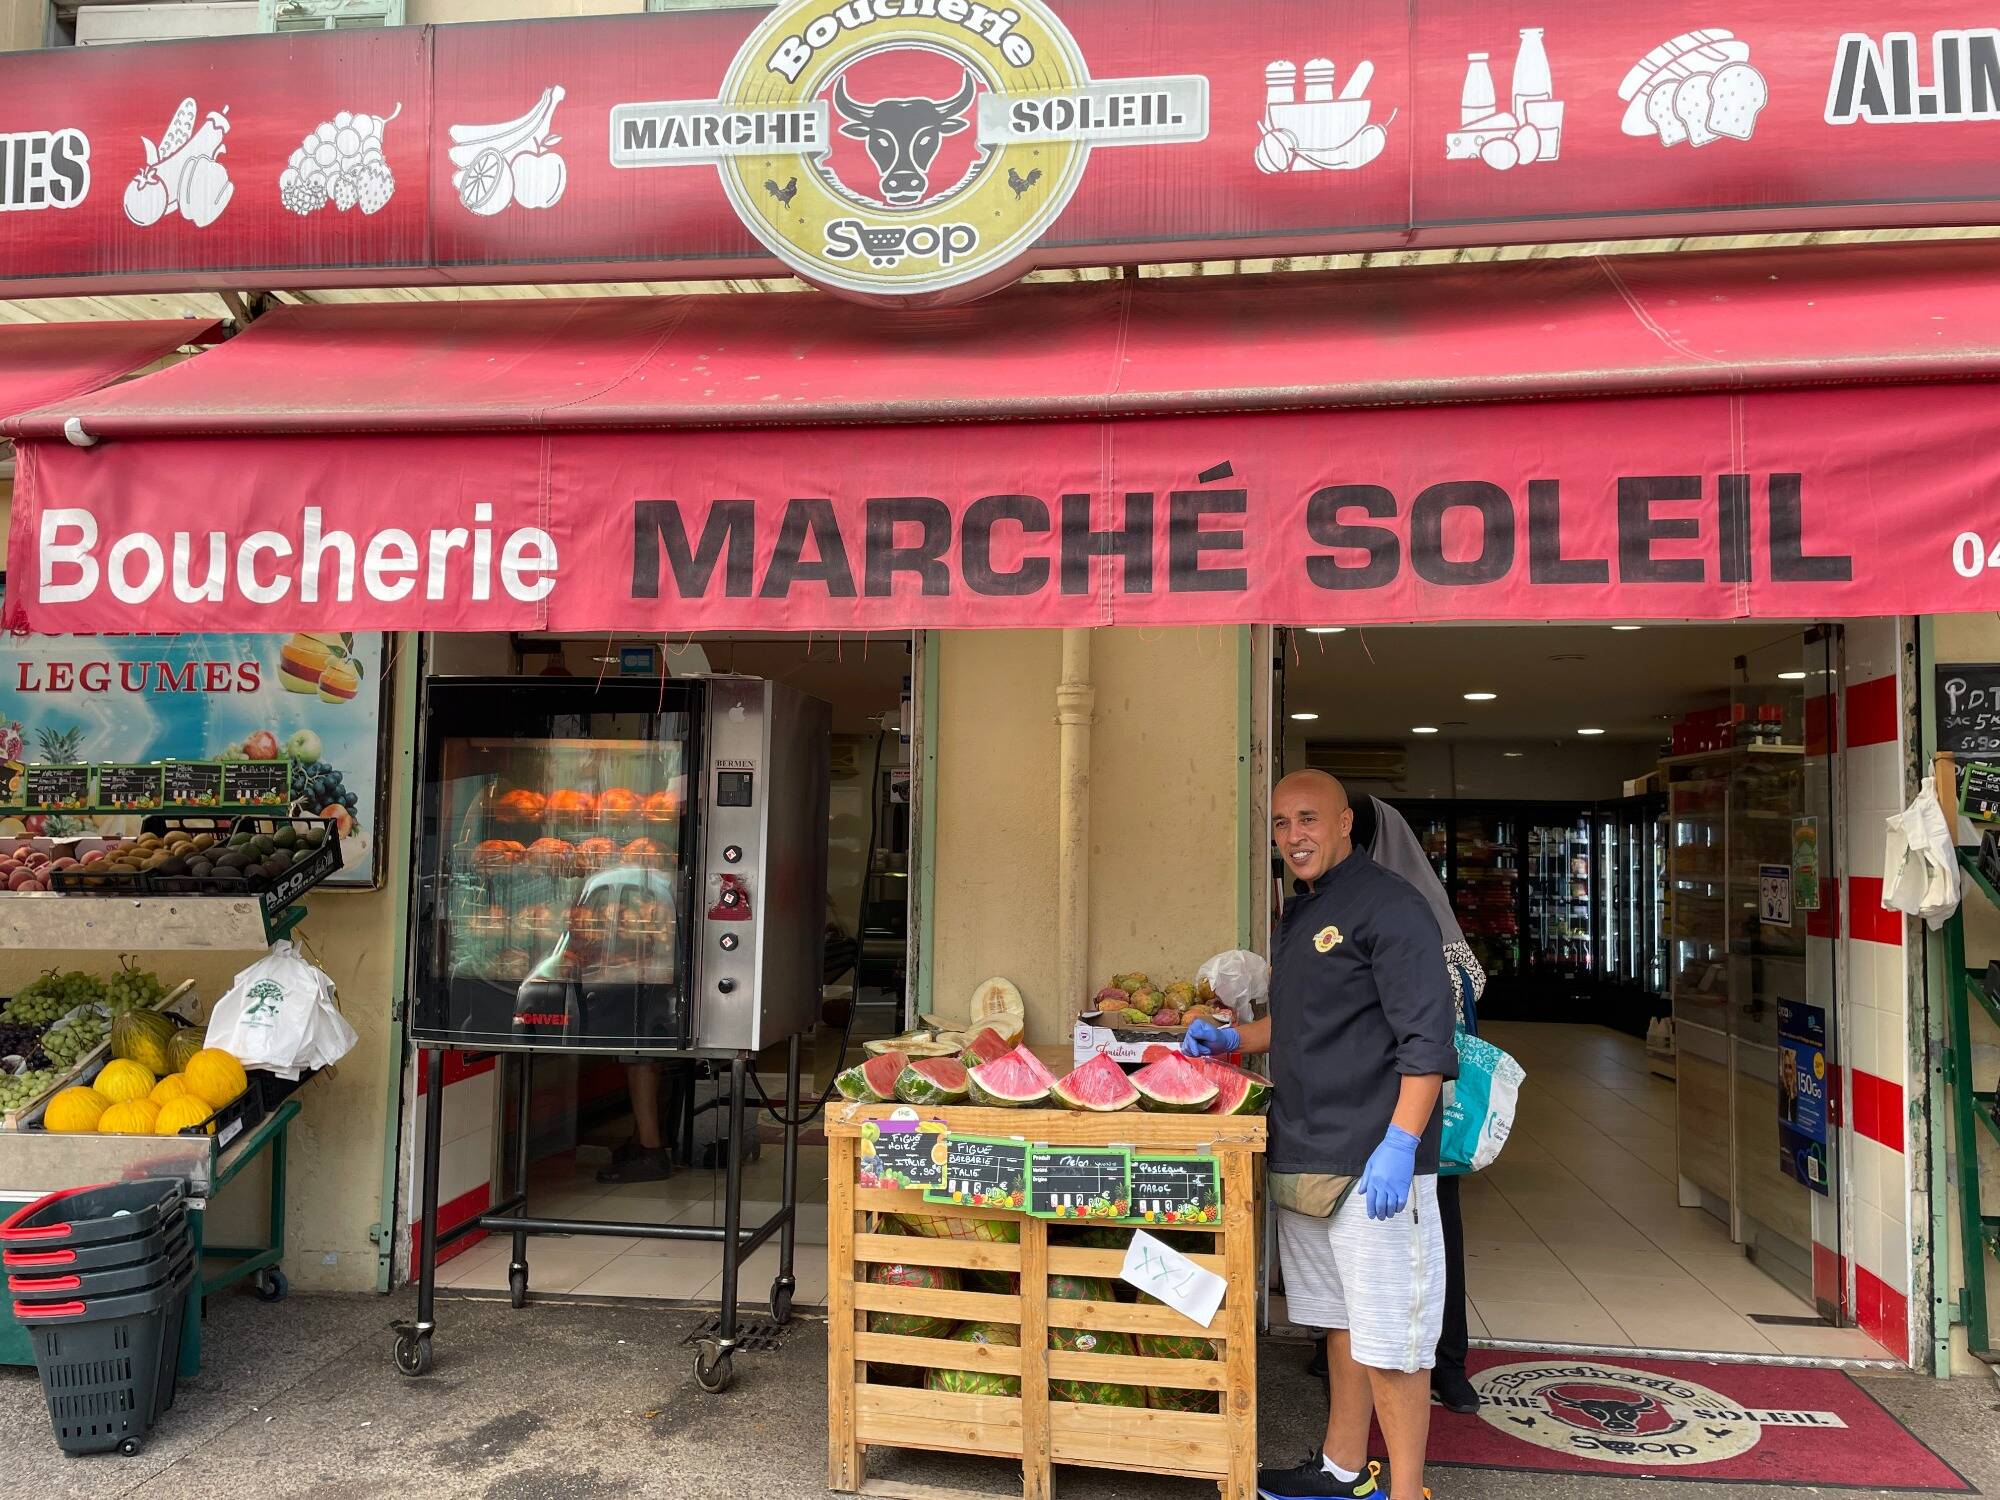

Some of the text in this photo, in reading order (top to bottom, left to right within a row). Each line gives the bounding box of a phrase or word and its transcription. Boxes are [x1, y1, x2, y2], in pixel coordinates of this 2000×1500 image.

[623, 94, 1183, 150] MARCHE SOLEIL
[38, 502, 559, 604] Boucherie
[631, 460, 1248, 598] MARCHÉ
[1306, 472, 1852, 590] SOLEIL
[15, 661, 261, 693] LEGUMES
[513, 1012, 569, 1026] ONVE
[891, 1132, 923, 1144] FIGUE
[957, 1142, 993, 1155] FIGUE
[1493, 1366, 1696, 1399] Boucherie
[1692, 1409, 1830, 1425] SOLEIL
